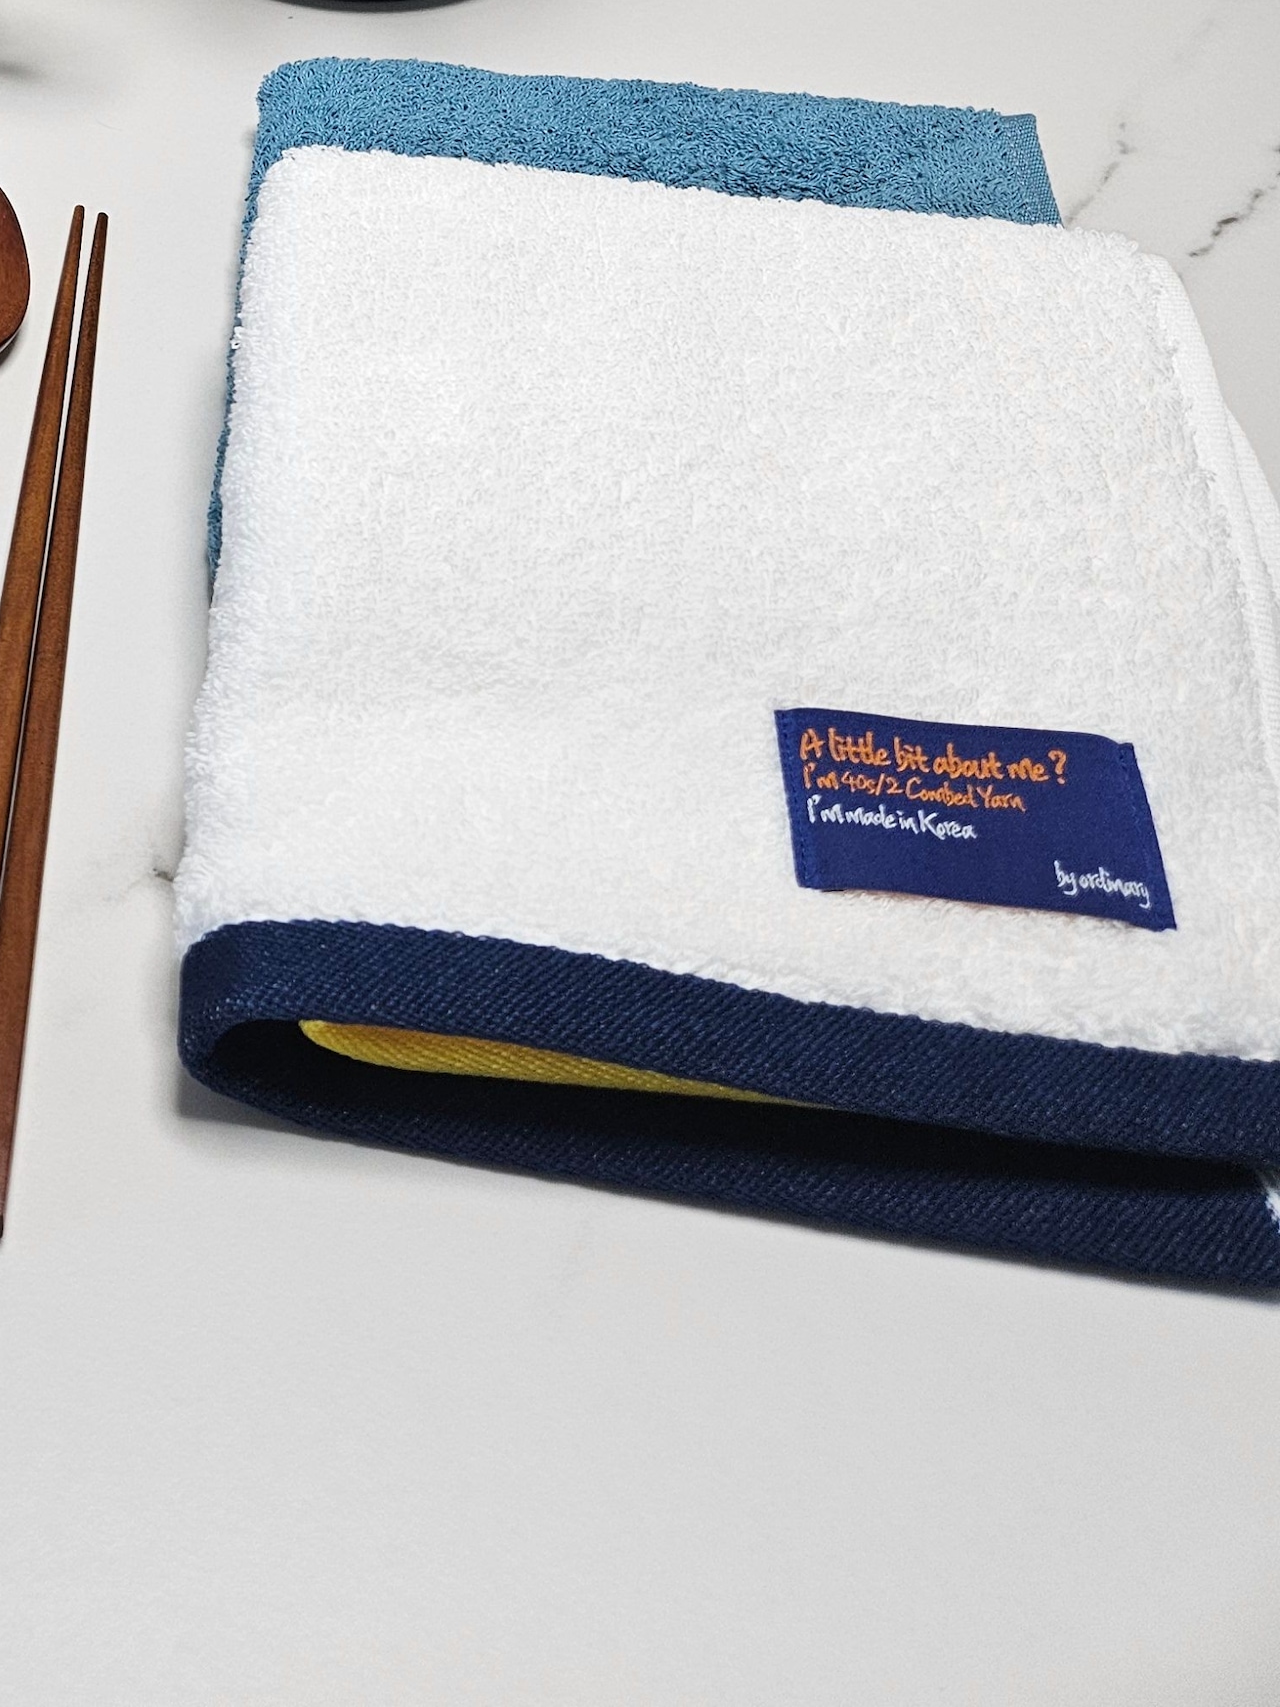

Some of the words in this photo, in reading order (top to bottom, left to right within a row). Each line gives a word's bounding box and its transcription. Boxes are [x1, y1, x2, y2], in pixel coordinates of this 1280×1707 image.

[800, 727, 825, 761] A
[828, 727, 891, 766] little
[894, 736, 930, 772] bit
[933, 742, 1004, 780] about
[803, 762, 839, 790] I'm
[906, 776, 978, 808] Combed
[977, 784, 1026, 813] Yarn
[806, 794, 844, 824] I'm
[845, 804, 897, 829] made
[898, 810, 919, 834] in
[919, 809, 977, 840] Korea
[1054, 860, 1077, 895] by
[1079, 866, 1151, 909] ordinary
